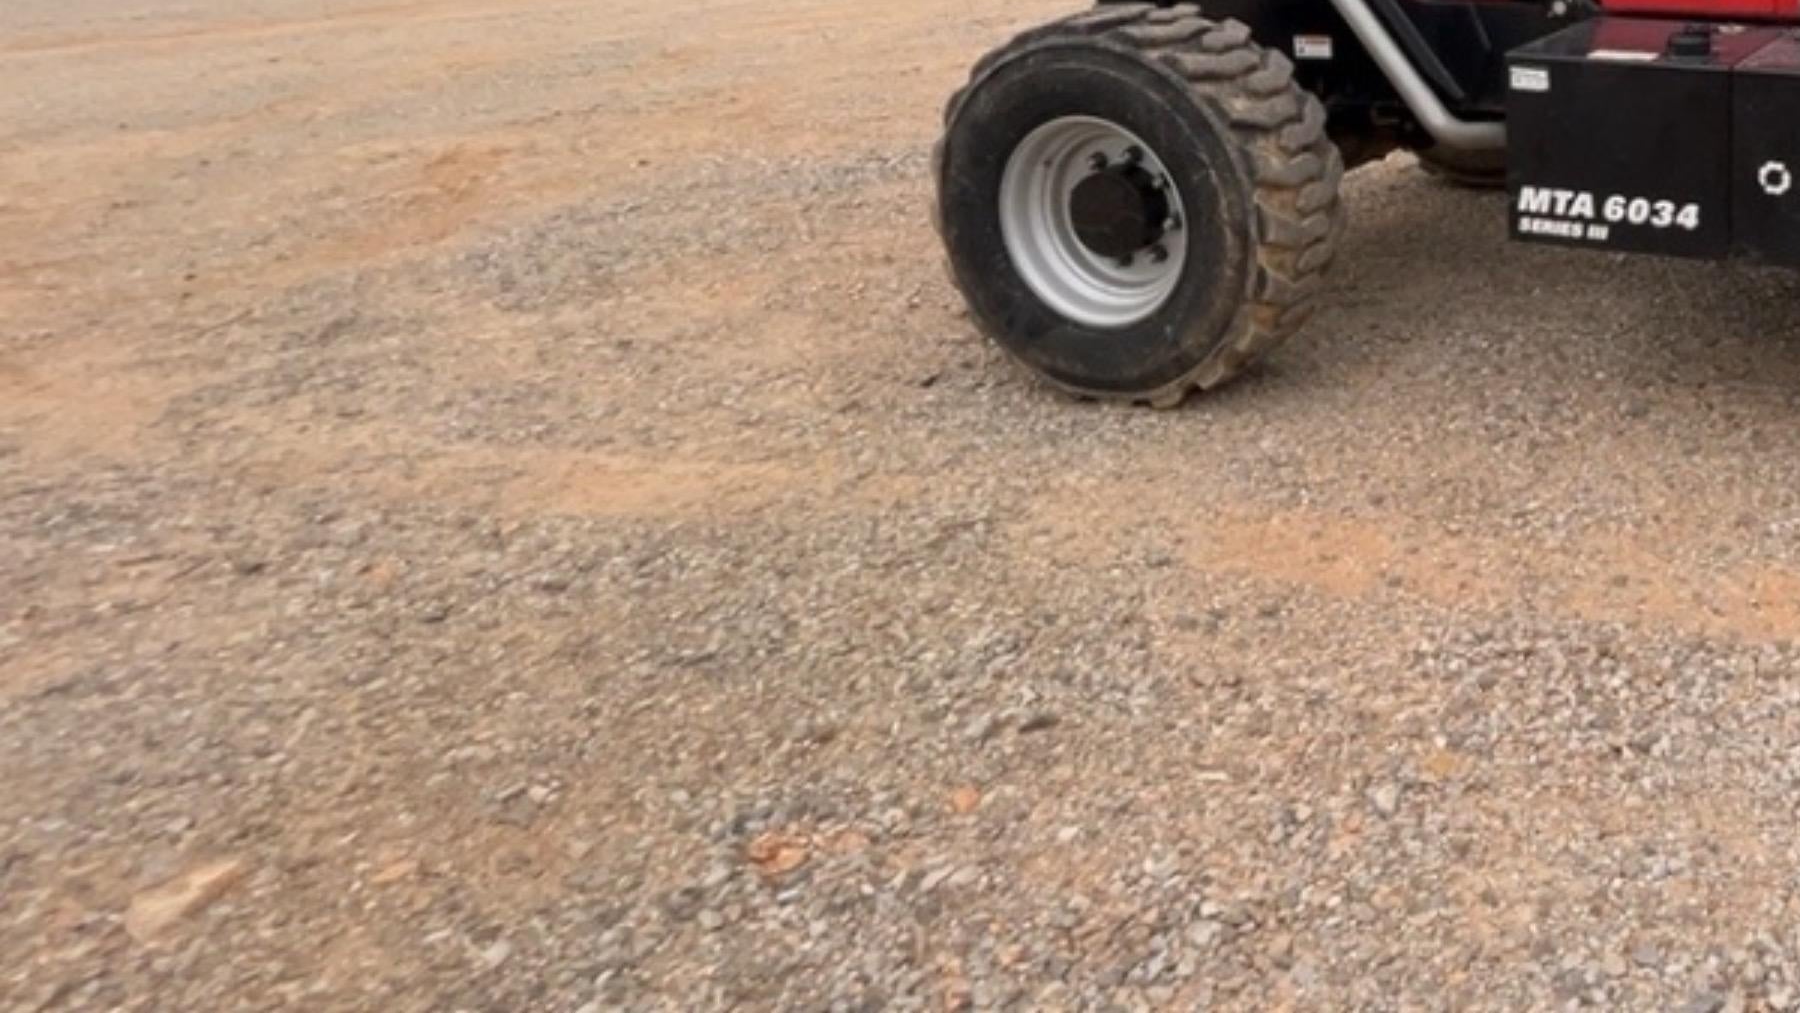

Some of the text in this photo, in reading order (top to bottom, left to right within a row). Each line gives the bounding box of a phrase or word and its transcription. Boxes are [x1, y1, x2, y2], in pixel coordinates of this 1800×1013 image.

[1517, 185, 1700, 231] MTA 6034
[1517, 216, 1584, 239] SERIES
